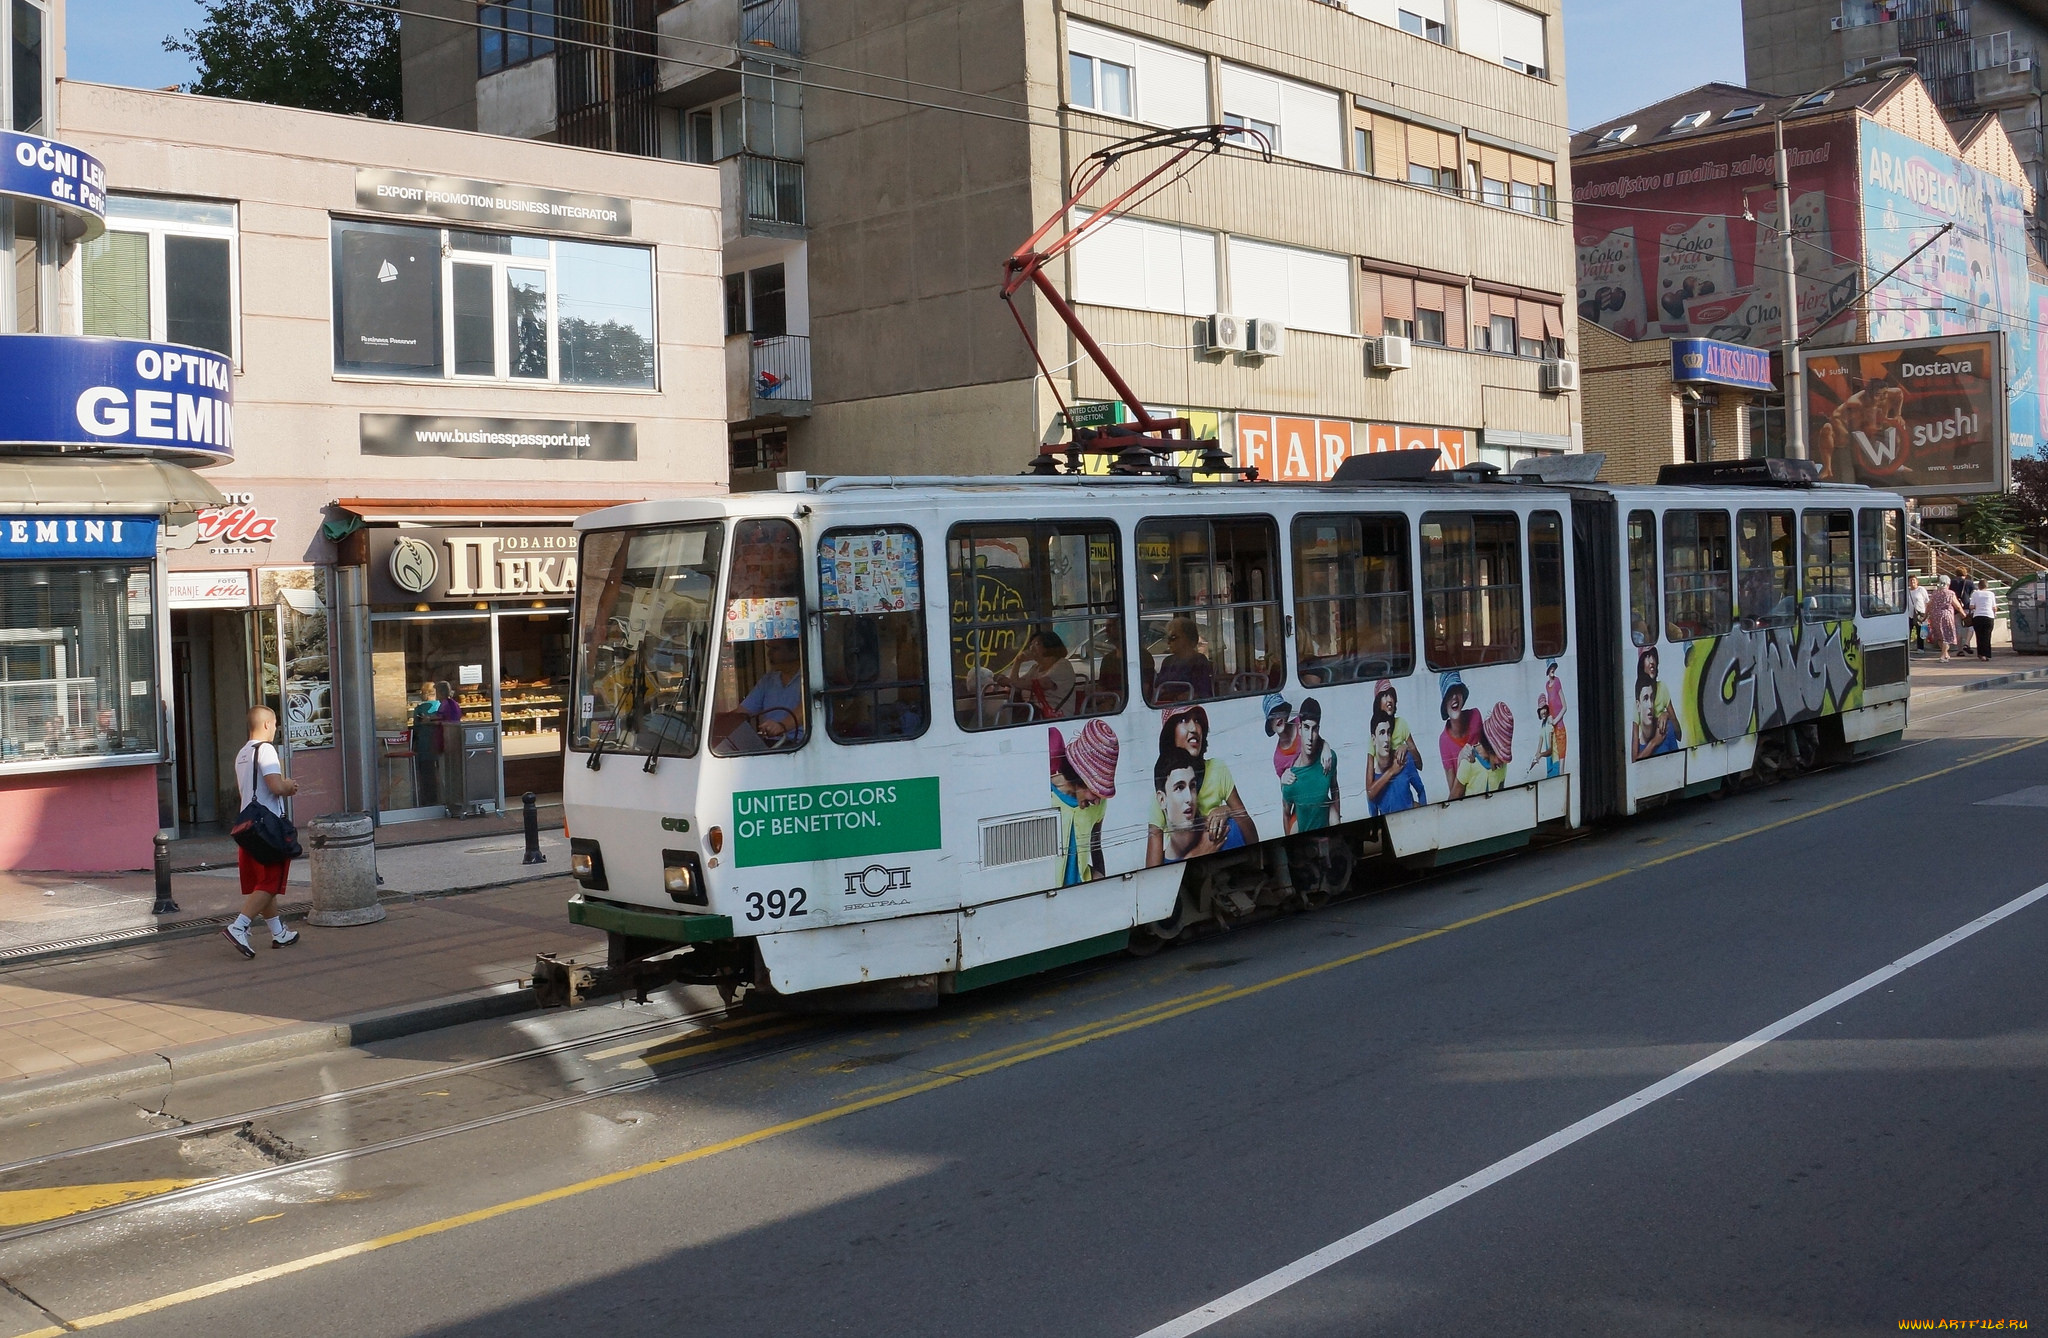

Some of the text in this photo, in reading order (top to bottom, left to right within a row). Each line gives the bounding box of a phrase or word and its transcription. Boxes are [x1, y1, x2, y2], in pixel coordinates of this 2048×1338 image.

[16, 141, 78, 178] OČNI
[1572, 142, 1831, 200] adovoljstvo u malim zalogjima!
[51, 176, 76, 201] dr.
[377, 184, 617, 222] EXPORT PROMOTION BUSINESS INTEGRATOR
[136, 349, 230, 393] OPTIKA
[1829, 366, 1849, 376] sushi
[1902, 360, 1973, 378] Dostava
[1087, 404, 1109, 414] COLORS
[416, 428, 591, 448] www.businesspassport.net
[1912, 407, 1979, 447] sushi
[0, 520, 123, 543] EMINI
[168, 586, 199, 600] PIRANJE
[583, 702, 592, 713] 13
[737, 786, 897, 815] UNITED COLORS
[738, 810, 881, 838] OF BENETTON.
[745, 887, 808, 922] 392
